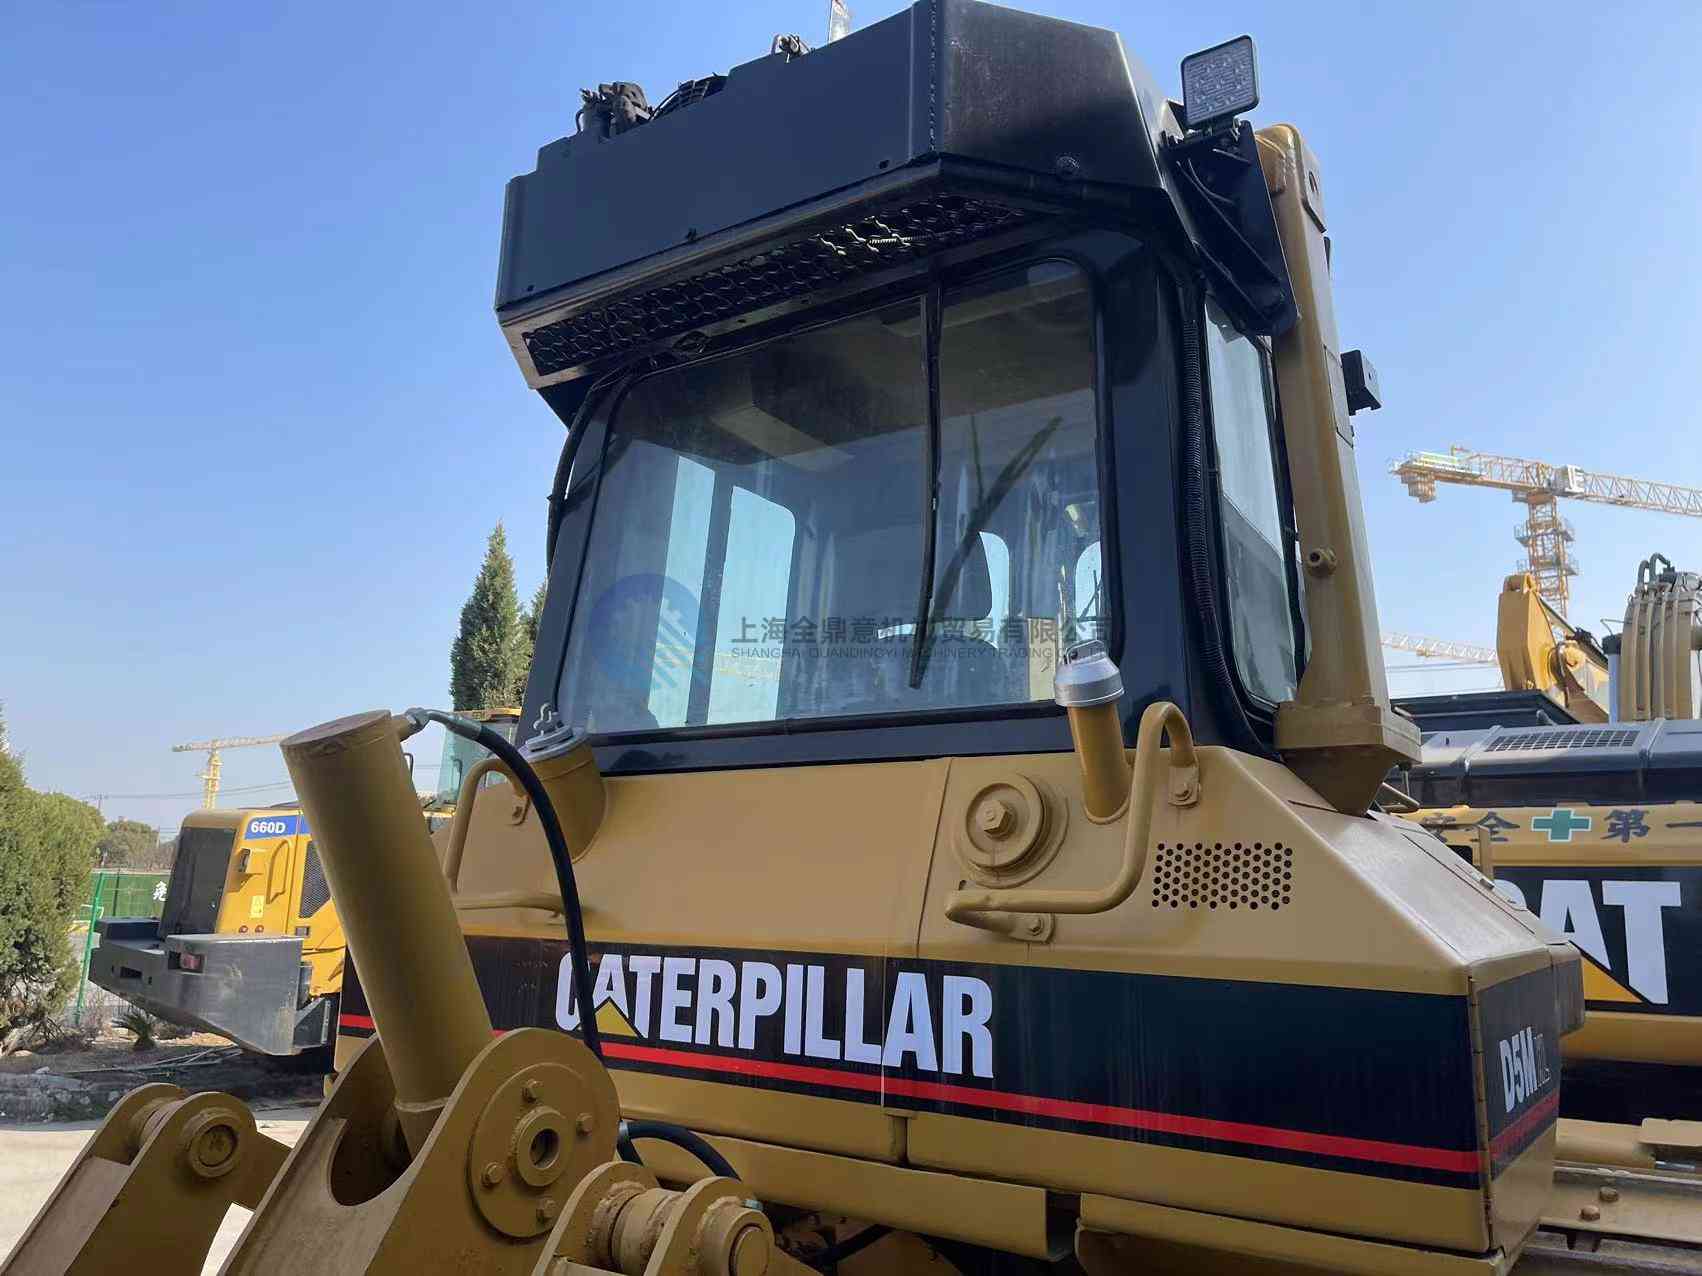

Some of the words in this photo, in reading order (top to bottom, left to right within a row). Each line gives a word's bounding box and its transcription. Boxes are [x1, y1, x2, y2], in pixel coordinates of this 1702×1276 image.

[250, 820, 286, 834] 660D
[1493, 879, 1682, 1005] AT
[555, 952, 994, 1079] CATERPILLAR
[1499, 1026, 1538, 1113] D5M
